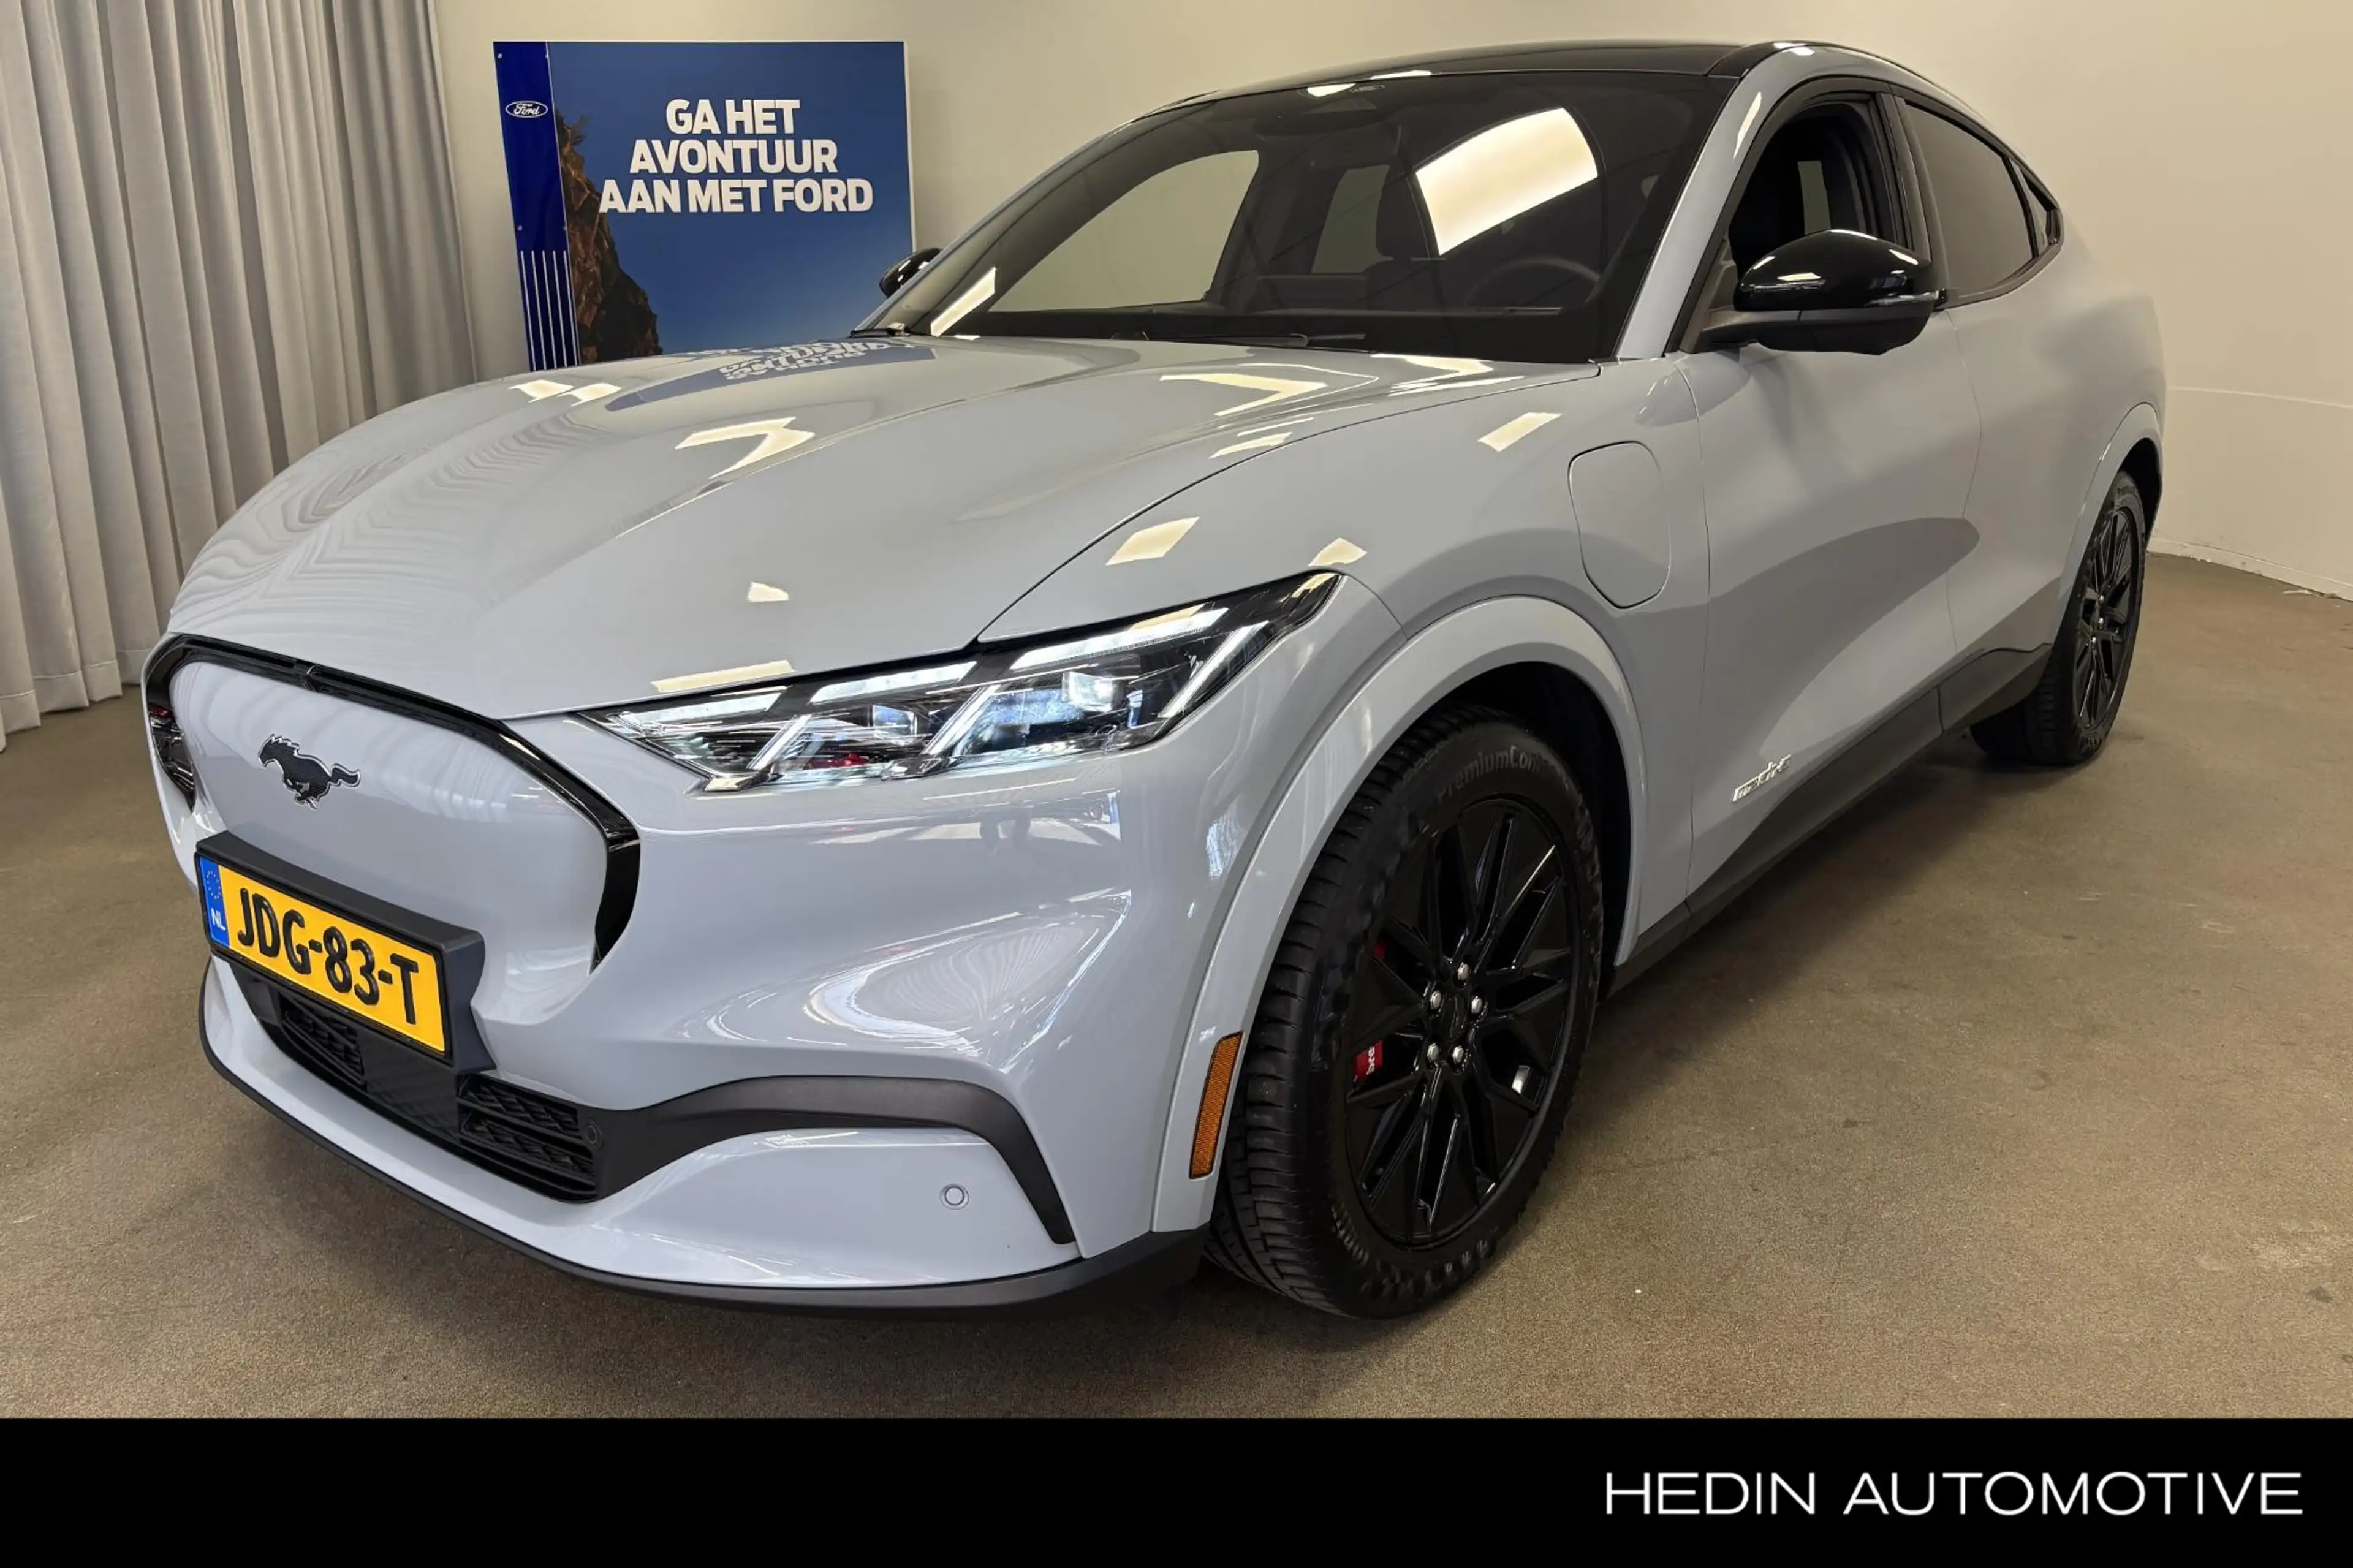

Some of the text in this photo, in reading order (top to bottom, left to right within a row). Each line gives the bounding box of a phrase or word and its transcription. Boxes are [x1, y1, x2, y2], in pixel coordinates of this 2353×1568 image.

[513, 103, 540, 115] Ford
[666, 99, 800, 134] GA HET
[629, 139, 838, 173] AVONTUUR
[599, 178, 873, 213] AAN MET FORD
[211, 908, 226, 931] NL
[237, 888, 420, 1026] JDG-83-T
